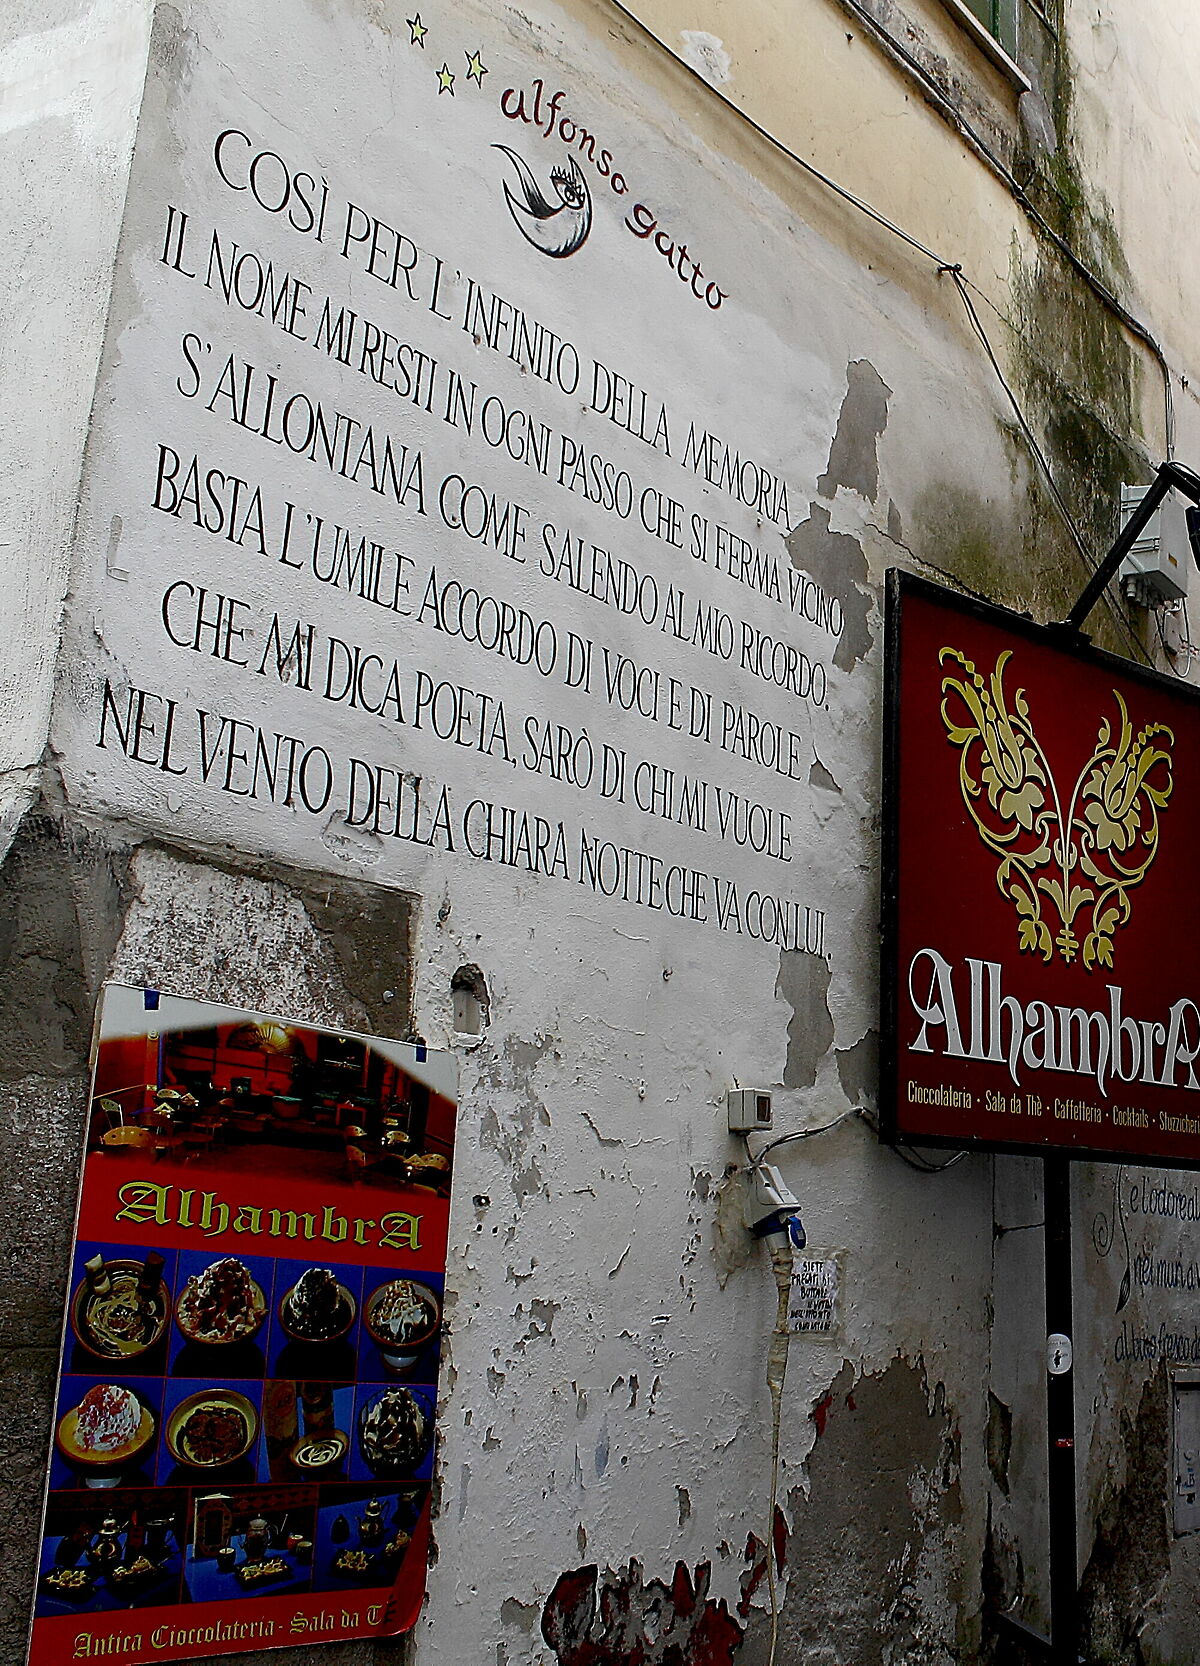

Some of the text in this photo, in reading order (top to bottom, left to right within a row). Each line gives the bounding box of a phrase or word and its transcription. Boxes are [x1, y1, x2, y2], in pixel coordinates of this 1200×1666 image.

[501, 80, 729, 310] alfonso gatto
[159, 205, 845, 638] IL NOME MI RESTI IN OGNI PASSO CHE SI FERMA VICINO
[214, 128, 796, 531] COSÌ PER L'INFINITO DELLA MEMORIA
[151, 444, 802, 781] BASTA L'UMILE ACCORDO DI VOCI E DI PAROLE
[176, 332, 829, 711] S'ALLONTANA COME SALENDO AL MIO RICORDO.
[95, 678, 833, 960] NEL VENTO DELLA CHIARA NOTTE CHE VA CON LUI.
[161, 581, 793, 863] CHE MI DICA POETA, SARÒ DI CHI MI VUOLE
[116, 1181, 424, 1251] AlhambrA
[908, 1080, 972, 1109] Cioccolateria
[986, 1090, 1006, 1112] Sala
[1010, 1093, 1022, 1114] da
[1026, 1095, 1042, 1116] Thè
[1054, 1098, 1102, 1123] Caffetteria
[1112, 1105, 1149, 1128] Cocktails
[1130, 1185, 1138, 1213] e
[1114, 1321, 1132, 1363] al
[1157, 1323, 1190, 1361] fresco
[72, 1631, 142, 1659] Antica
[289, 1611, 334, 1634] Sala
[341, 1609, 359, 1628] da
